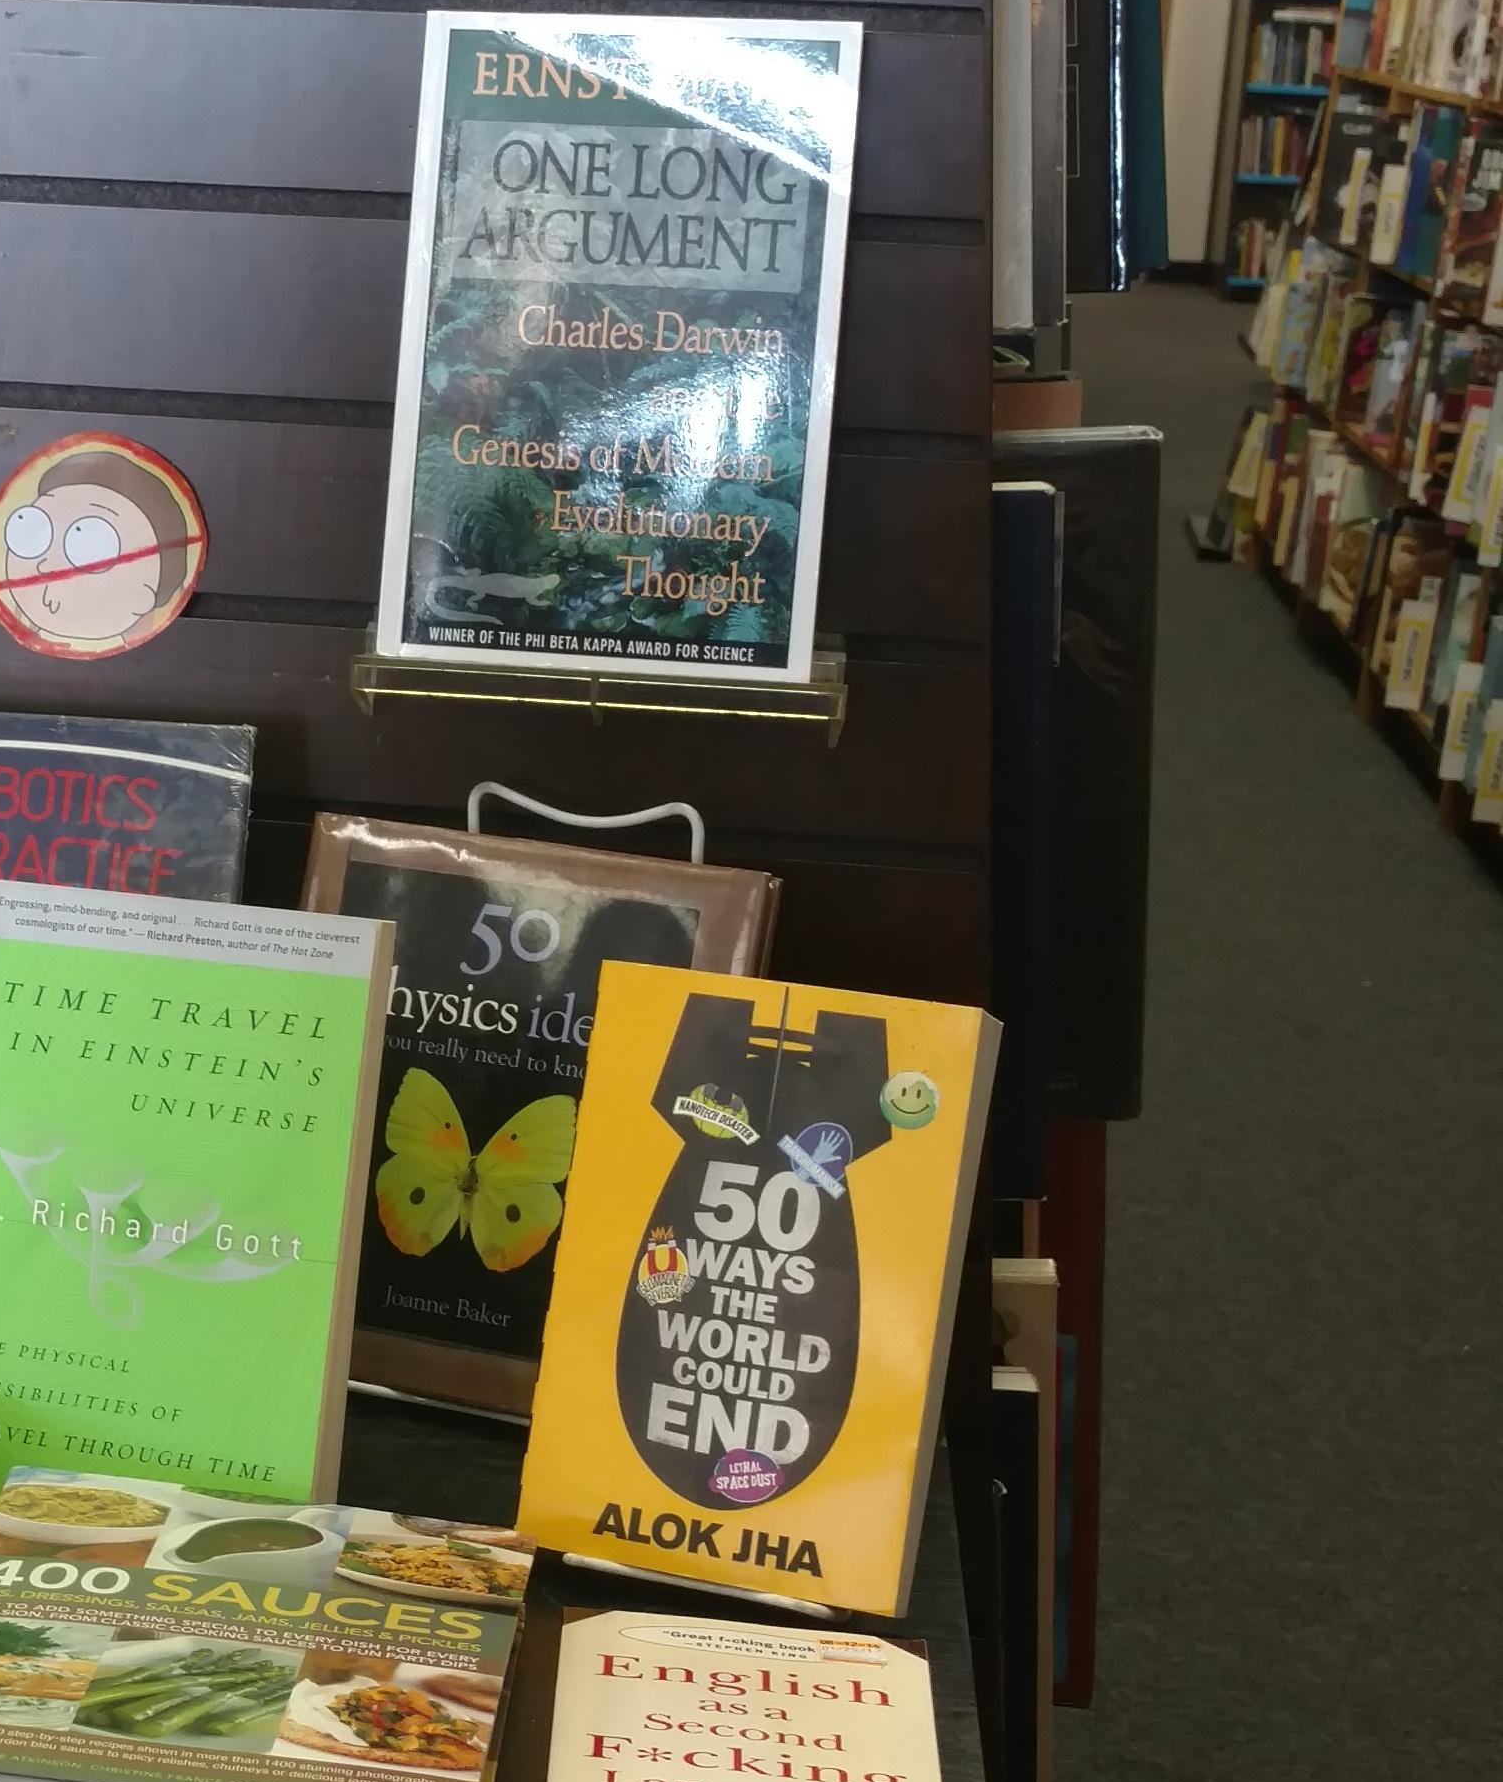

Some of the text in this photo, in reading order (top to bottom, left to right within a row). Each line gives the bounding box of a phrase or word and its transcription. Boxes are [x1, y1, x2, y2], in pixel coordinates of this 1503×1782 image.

[494, 139, 797, 206] ONE LONG
[458, 206, 796, 273] ARGUMENT
[518, 304, 783, 359] Charles Darwin
[452, 424, 773, 483] Genesis of Mern
[550, 490, 770, 557] Evolutionary
[617, 554, 766, 616] Thought
[429, 626, 755, 663] WINNER OF THE PHI BETA KAPPA AWARD FOR SCIENCE
[459, 903, 560, 976] 50
[4, 981, 326, 1040] TIME TRAVEL
[386, 965, 519, 1034] hysics
[9, 1031, 324, 1087] IN EINSTEIN'S
[418, 1038, 547, 1072] really need to
[131, 1092, 319, 1133] UNIVERSE
[678, 1099, 754, 1141] NANOTECH DISASTER
[32, 1198, 189, 1246] Richard
[216, 1224, 303, 1261] Gott
[694, 1160, 821, 1252] 50
[686, 1238, 816, 1294] WAYS
[711, 1286, 778, 1324] THE
[18, 1344, 131, 1374] PHYSICAL
[658, 1310, 831, 1374] WORLD
[672, 1356, 795, 1403] COULD
[151, 1405, 184, 1422] OF
[647, 1383, 811, 1466] END
[64, 1434, 194, 1471] THROUGH
[209, 1457, 277, 1483] TIME
[716, 1473, 776, 1490] SPACE DUST
[729, 1461, 762, 1473] LETHAL
[592, 1502, 825, 1578] ALOK JHA
[146, 1574, 484, 1640] SAUCES
[595, 1653, 895, 1707] English
[643, 1713, 846, 1752] Second
[698, 1698, 792, 1721] as a
